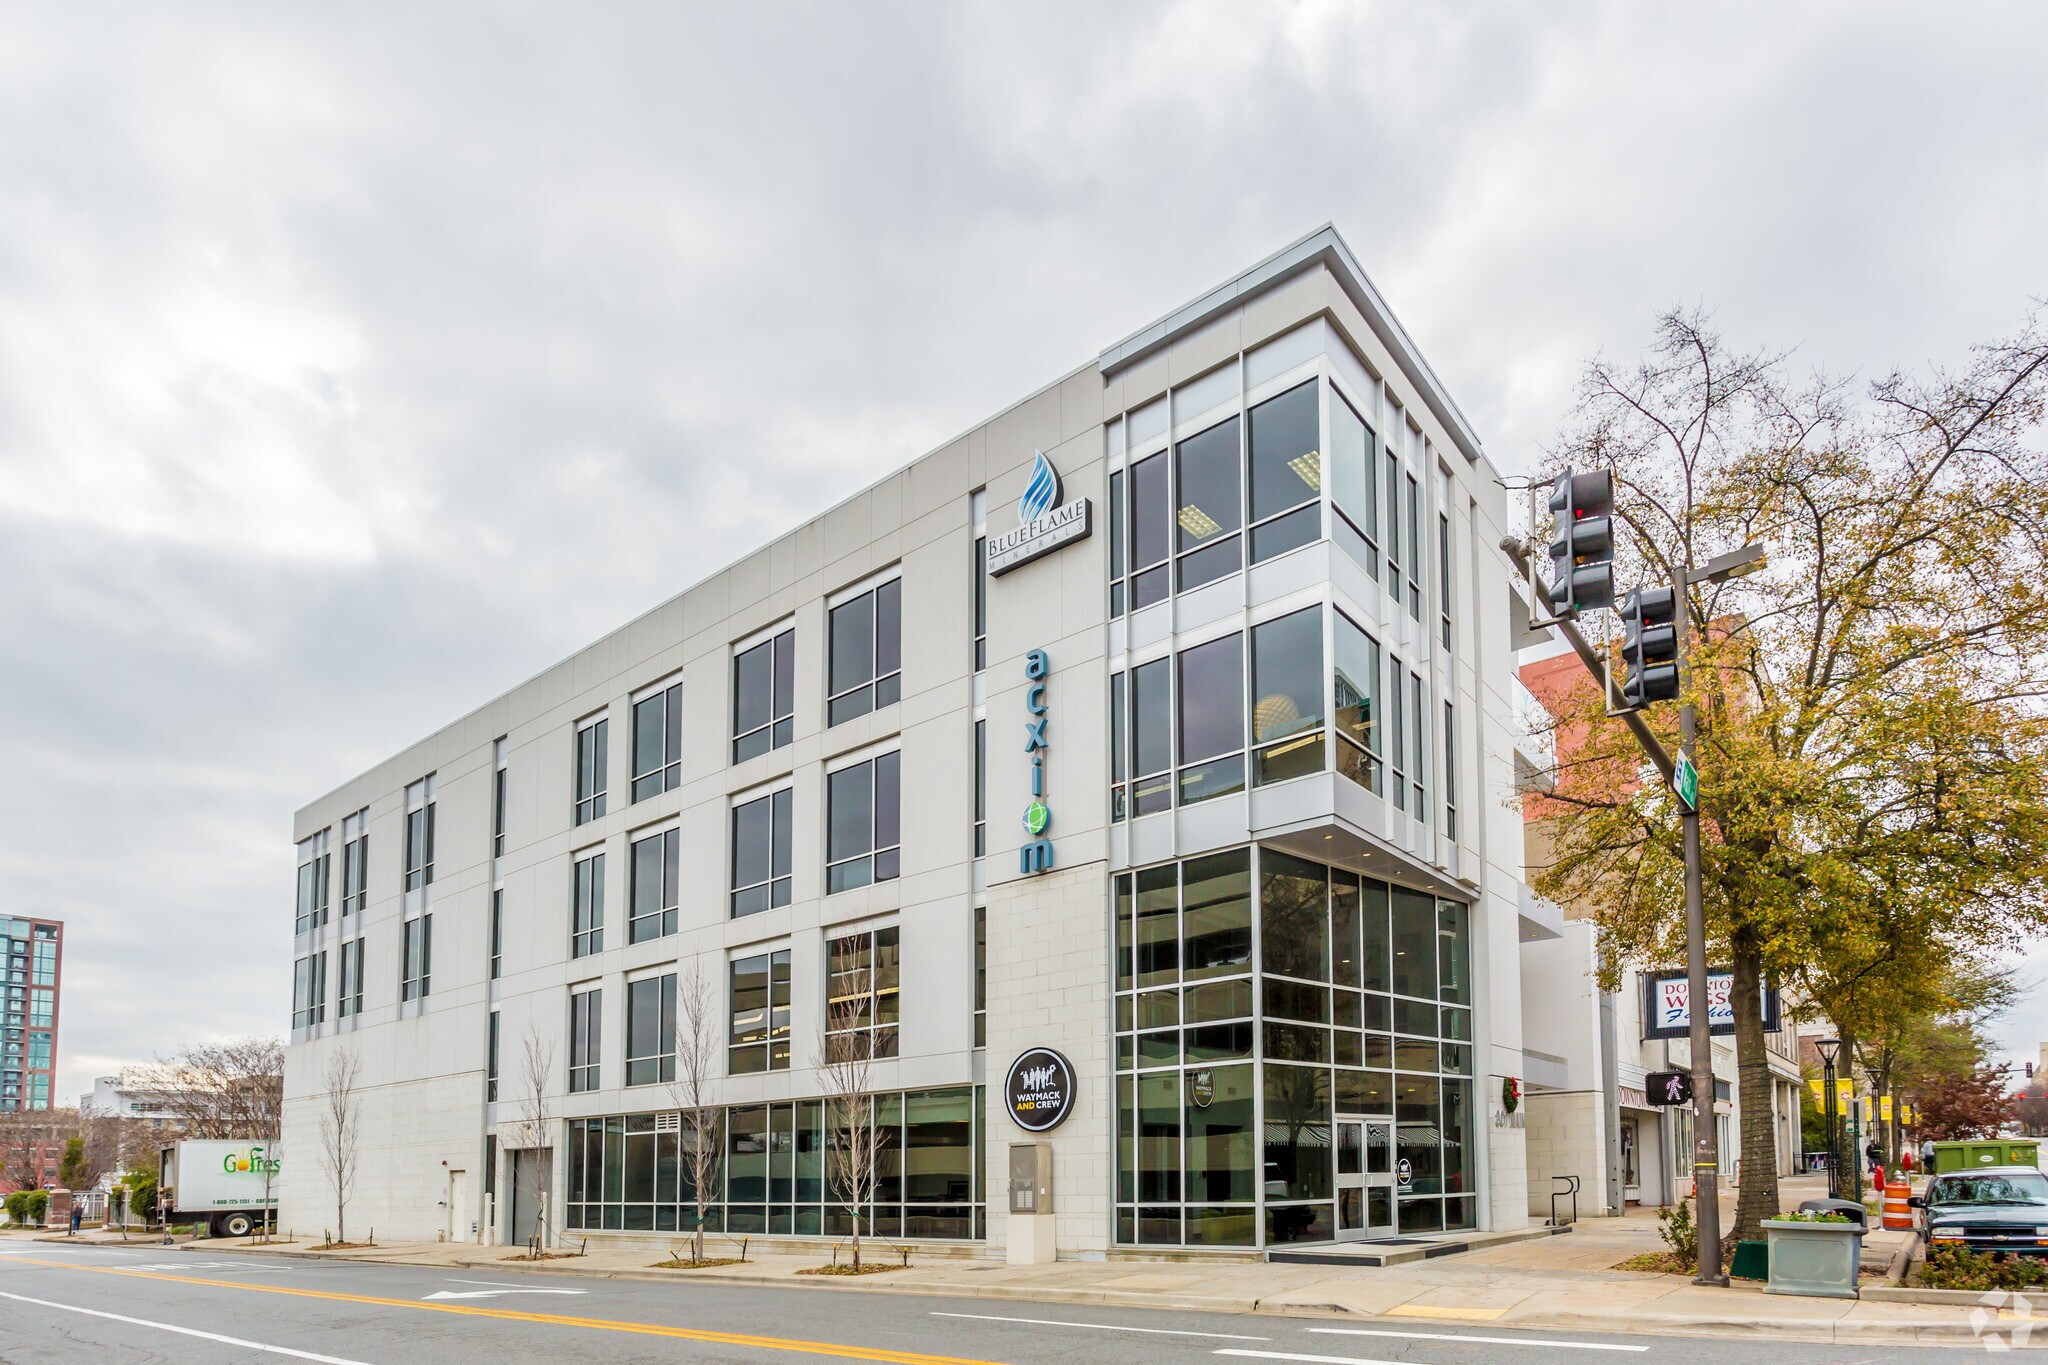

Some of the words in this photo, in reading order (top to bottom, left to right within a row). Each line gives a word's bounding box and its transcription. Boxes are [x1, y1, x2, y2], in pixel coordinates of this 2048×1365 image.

[988, 500, 1083, 557] BLUEFLAME
[988, 521, 1083, 570] MINERALS
[1017, 1091, 1060, 1102] WAYMACK
[1017, 1102, 1035, 1110] AND
[1035, 1099, 1060, 1109] CREW
